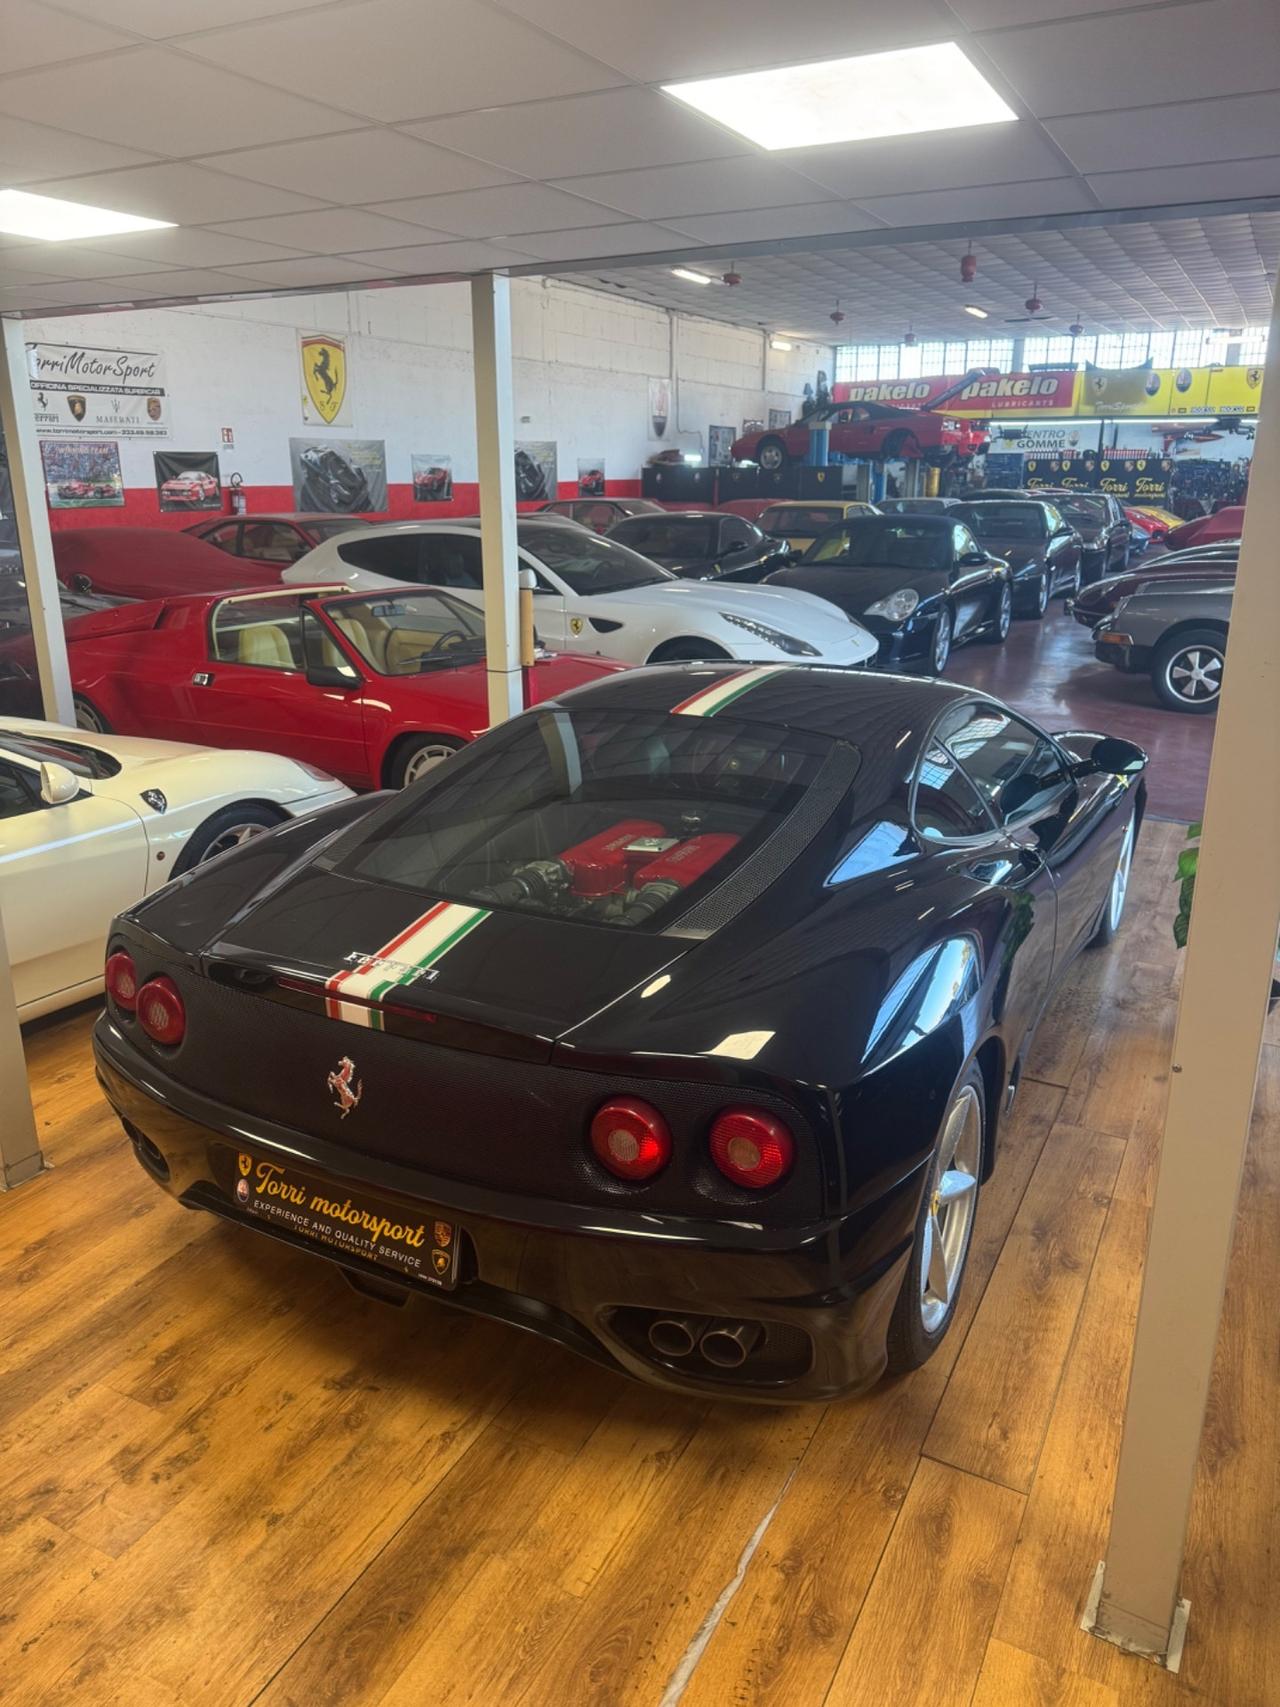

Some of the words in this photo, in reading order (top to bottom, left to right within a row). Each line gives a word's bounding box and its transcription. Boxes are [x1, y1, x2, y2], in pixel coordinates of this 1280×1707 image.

[30, 382, 67, 391] OFFICINA
[68, 384, 124, 394] SPECIALIZZATA
[850, 381, 931, 402] pakelo
[961, 376, 1059, 400] pakelo
[991, 399, 1055, 408] LUBRICANTS
[95, 415, 140, 425] MASERATI
[1025, 430, 1066, 439] ENTRO
[1016, 439, 1065, 449] GOMME
[1100, 477, 1129, 493] Torri
[1135, 477, 1165, 493] Torri
[255, 1161, 306, 1205] Torri
[309, 1195, 425, 1248] motorsport
[253, 1199, 309, 1227] EXPERIENCE
[311, 1221, 332, 1235] AND
[334, 1229, 376, 1251] QUALITY
[378, 1245, 422, 1268] SERVICE
